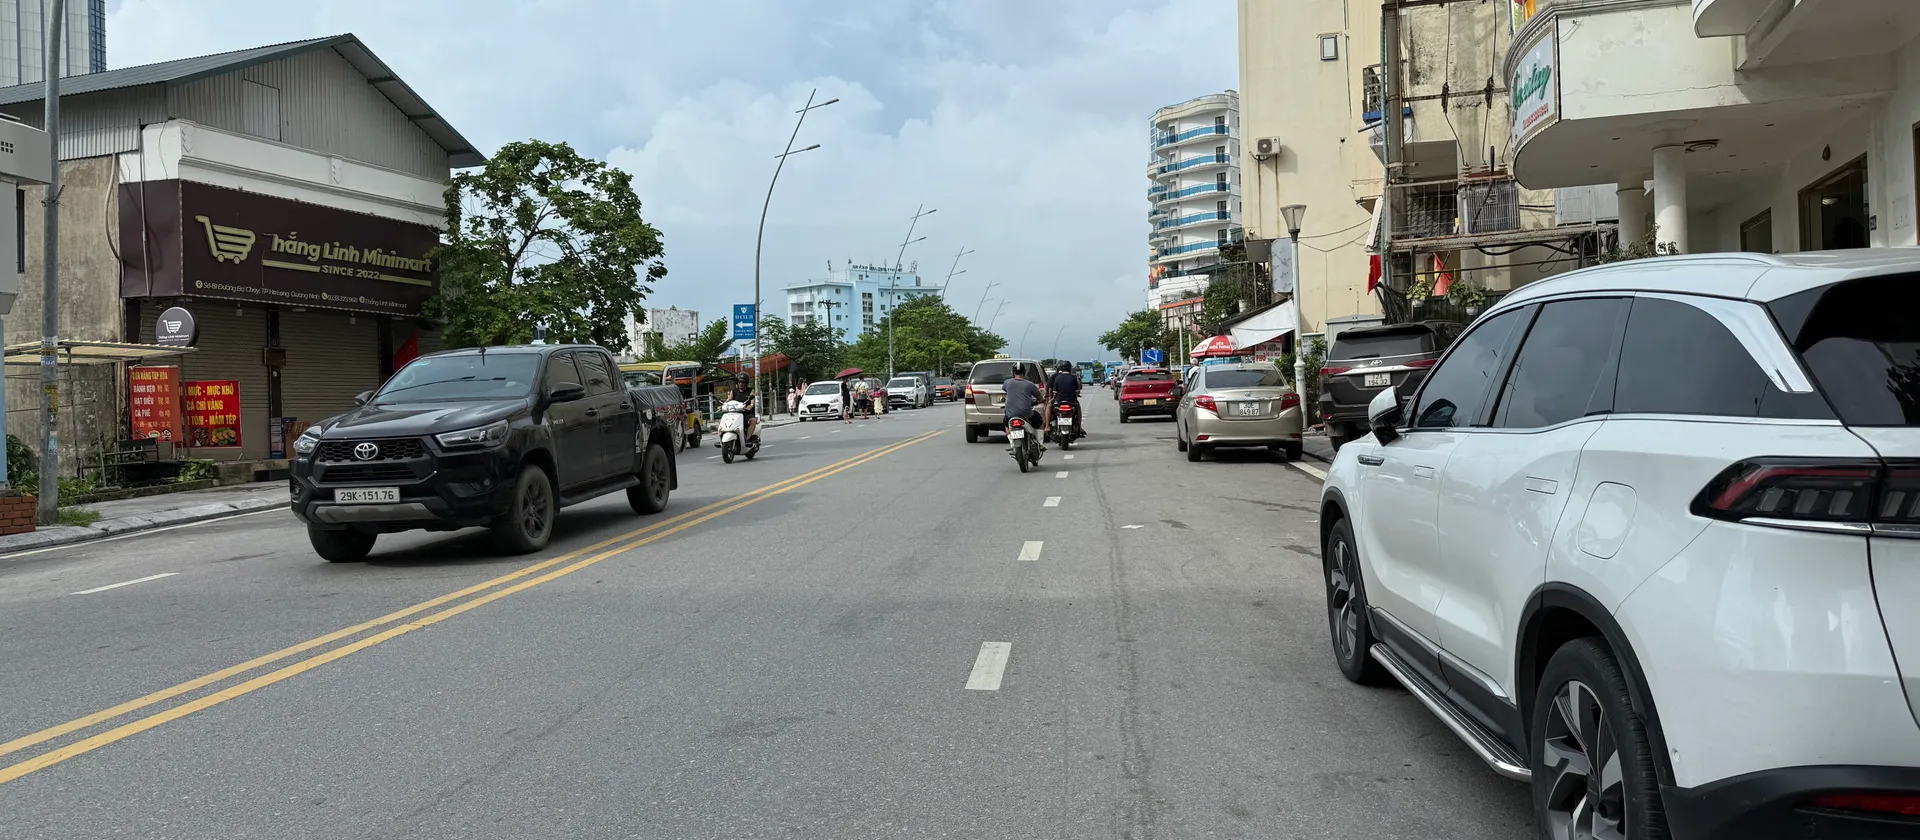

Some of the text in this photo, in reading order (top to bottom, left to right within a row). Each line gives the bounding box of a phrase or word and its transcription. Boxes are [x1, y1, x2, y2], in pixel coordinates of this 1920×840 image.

[322, 241, 359, 263] Linh
[361, 247, 432, 273] Minimart
[321, 265, 380, 280] SINCE 2022
[206, 384, 220, 398] MỰC
[206, 398, 224, 411] VÀNG
